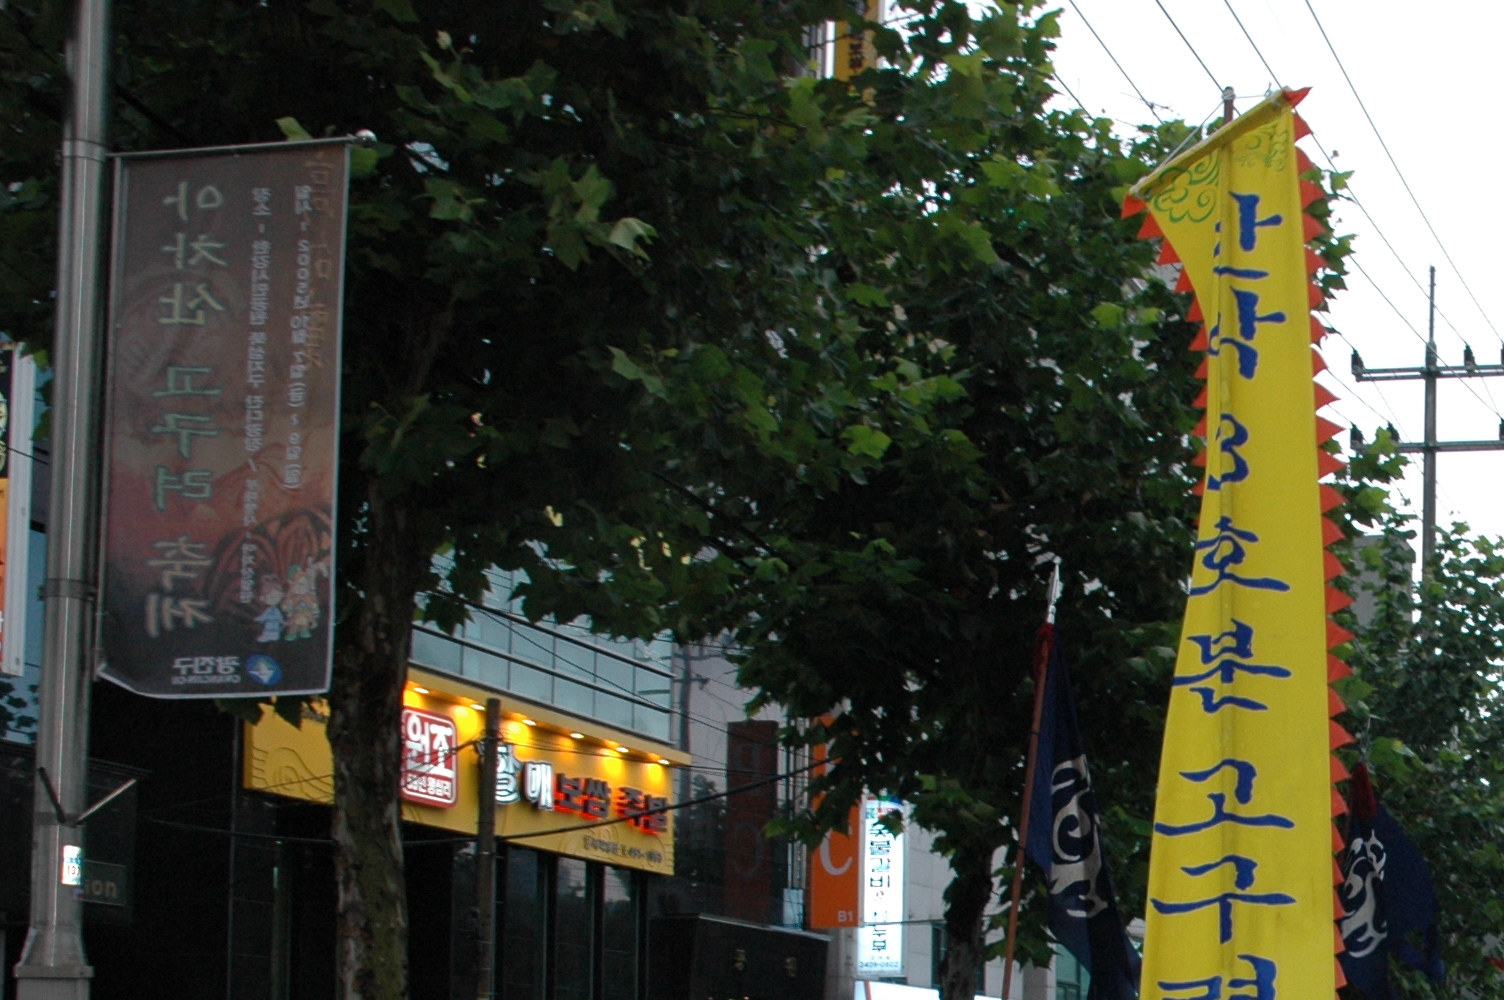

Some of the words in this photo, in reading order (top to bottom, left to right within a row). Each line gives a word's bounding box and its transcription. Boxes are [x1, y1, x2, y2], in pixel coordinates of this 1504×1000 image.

[404, 713, 455, 779] 원조
[555, 772, 611, 819] 보쌈
[617, 786, 668, 833] 족발
[837, 909, 854, 922] B1
